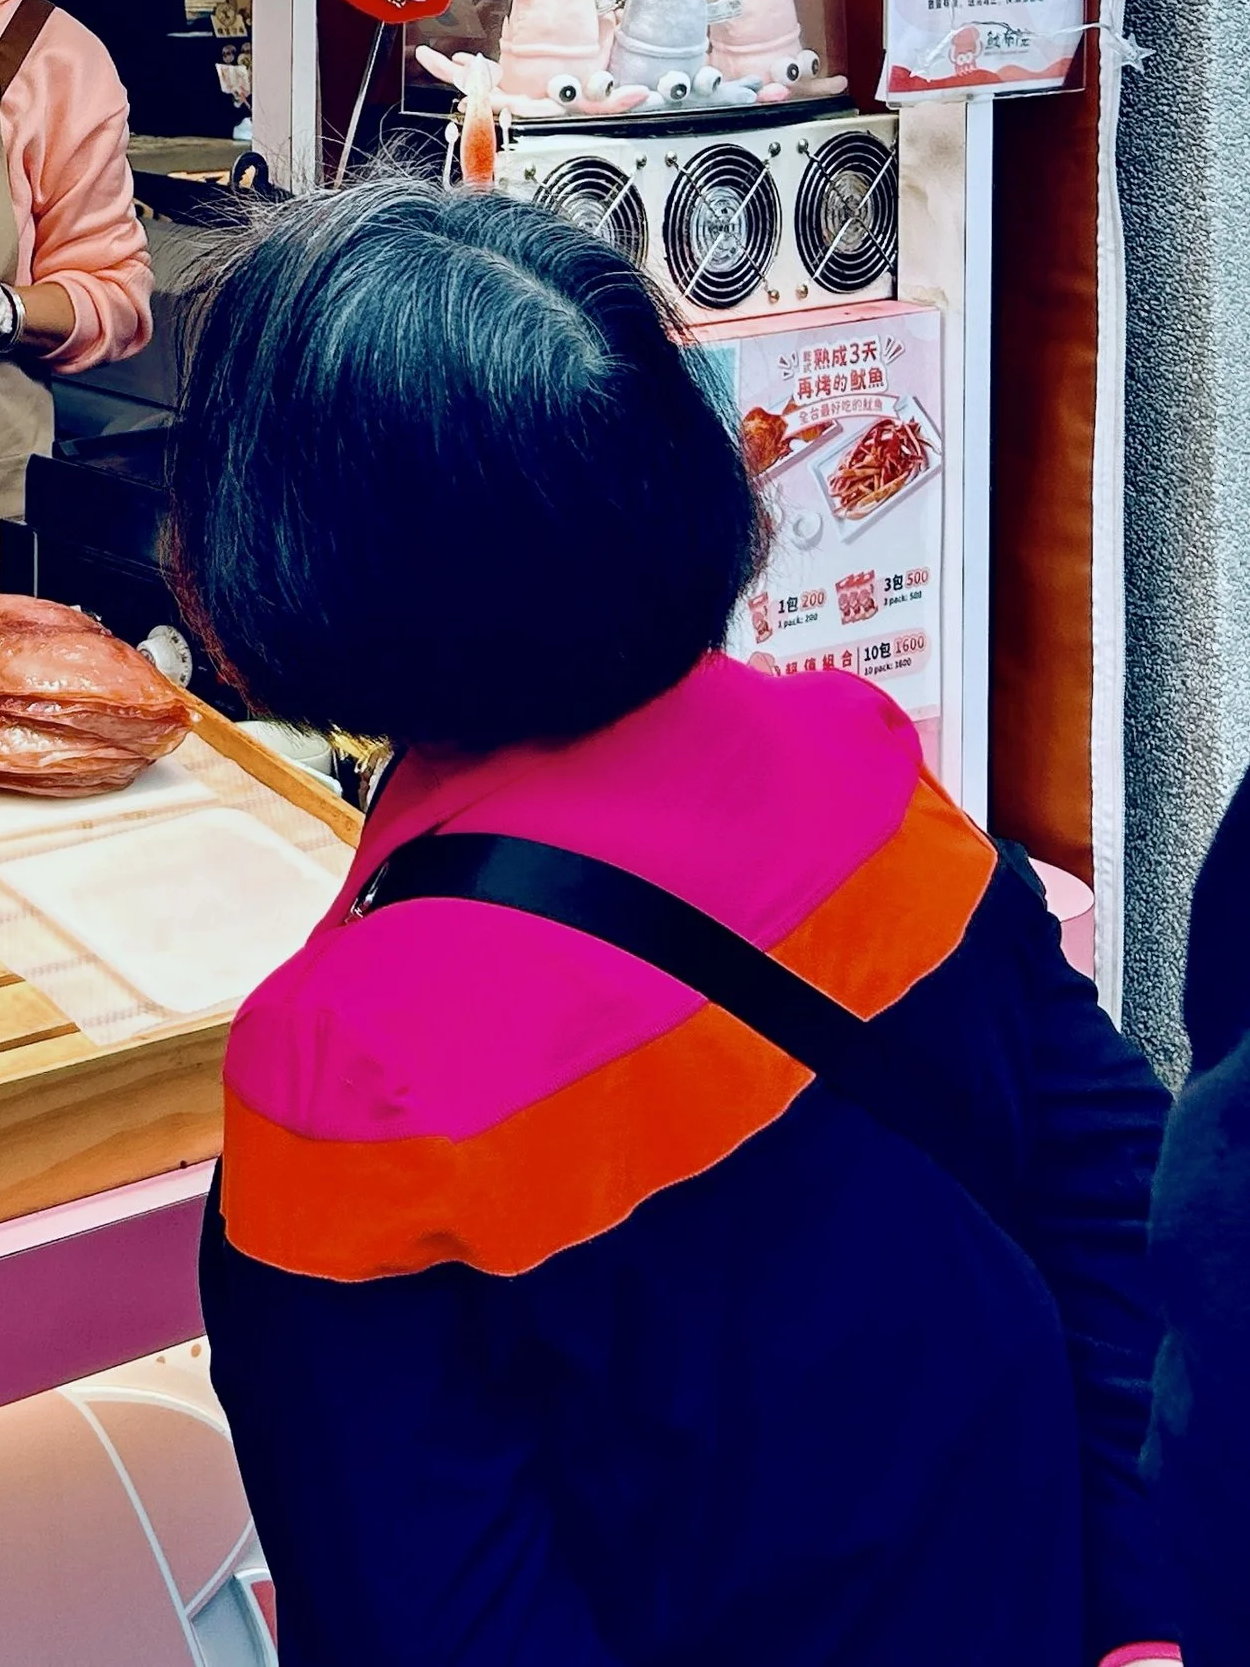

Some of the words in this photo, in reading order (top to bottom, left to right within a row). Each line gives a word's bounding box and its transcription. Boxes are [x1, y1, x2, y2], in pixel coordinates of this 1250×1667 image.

[796, 366, 885, 401] 再烤的魷魚
[798, 397, 884, 426] 全台最好吃的魷魚
[883, 574, 904, 592] 3包
[906, 570, 929, 587] 500
[778, 596, 799, 614] 1包
[801, 591, 825, 609] 200
[863, 642, 891, 662] 10包
[894, 635, 925, 654] 1600
